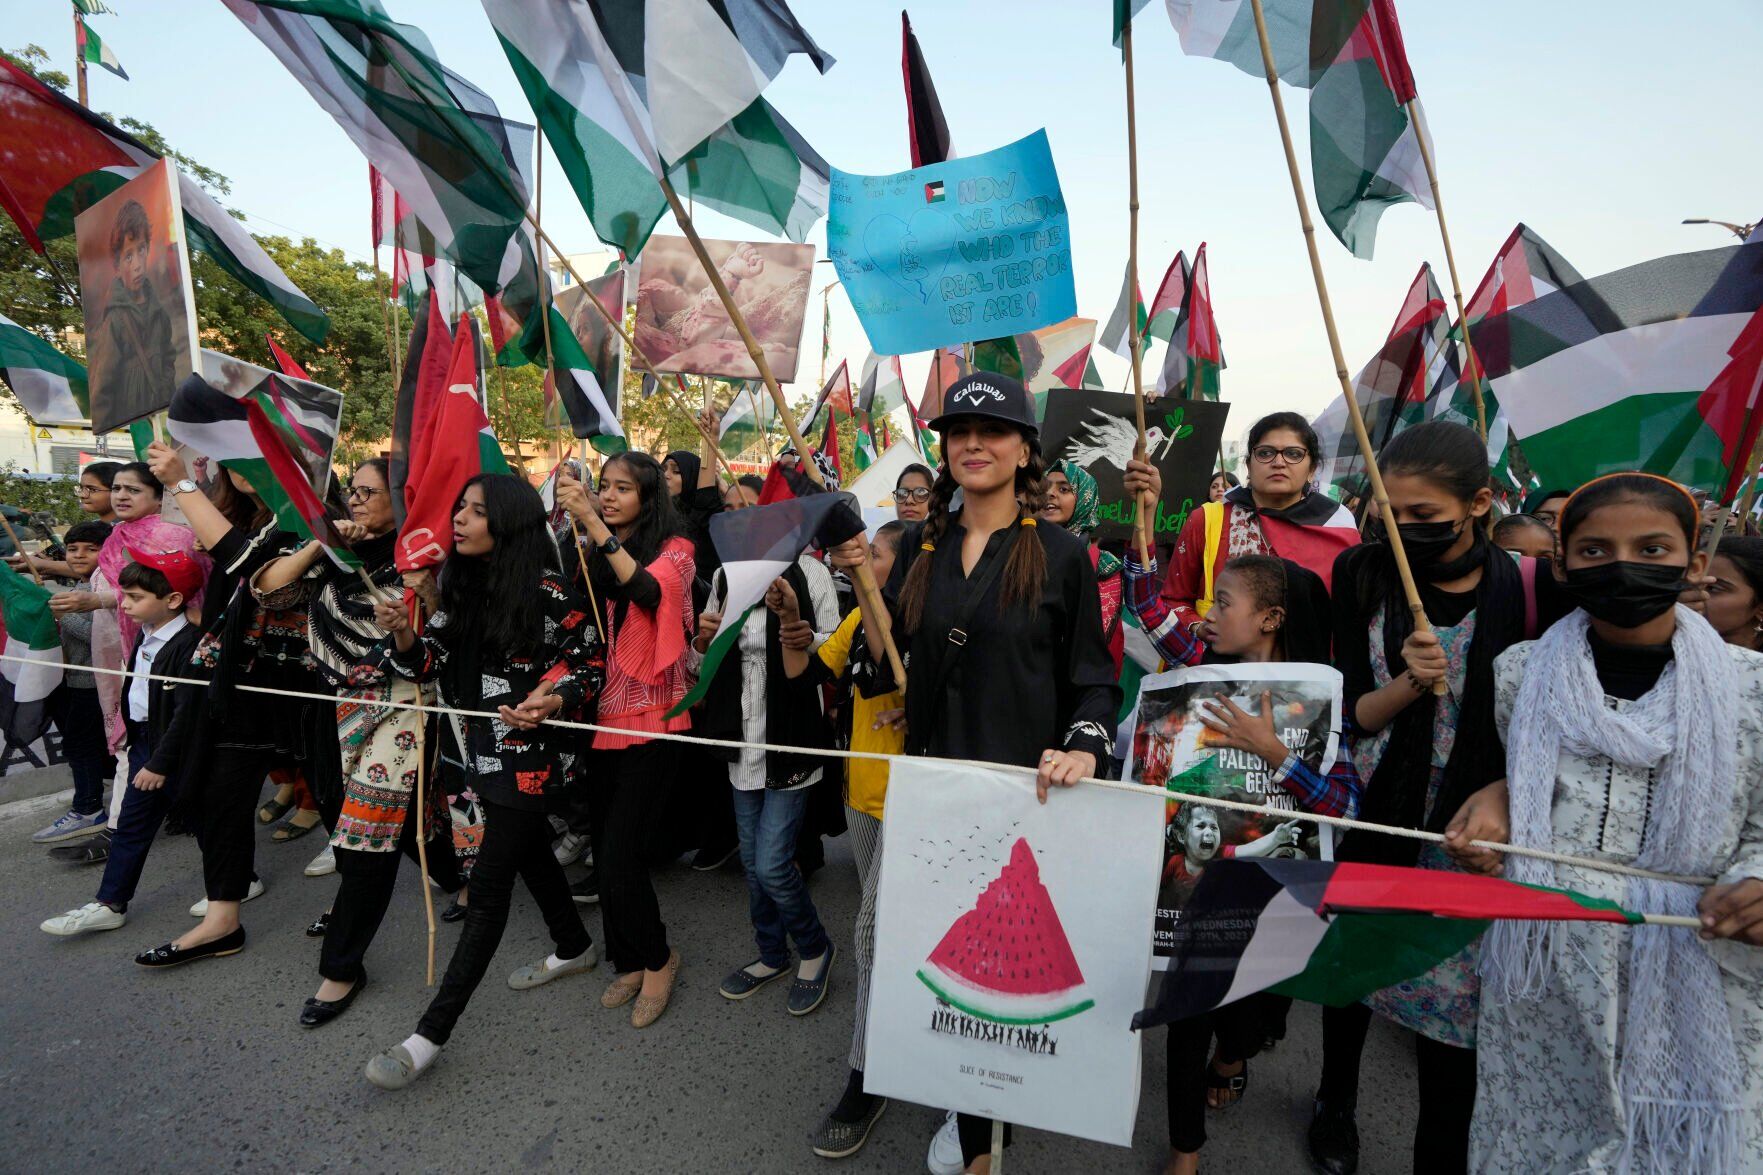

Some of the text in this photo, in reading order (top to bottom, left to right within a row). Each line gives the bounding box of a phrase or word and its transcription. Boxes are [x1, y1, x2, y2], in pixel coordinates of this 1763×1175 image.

[958, 172, 1016, 205] NOW
[954, 193, 1066, 232] WE KNOW
[958, 226, 1063, 263] WHO THE
[941, 272, 993, 301] REAL
[949, 302, 976, 325] IST
[953, 381, 1006, 402] Callaway
[1155, 498, 1192, 534] bef
[1283, 727, 1309, 749] END
[959, 1064, 1024, 1085] SLICE OF RESISTANCE
